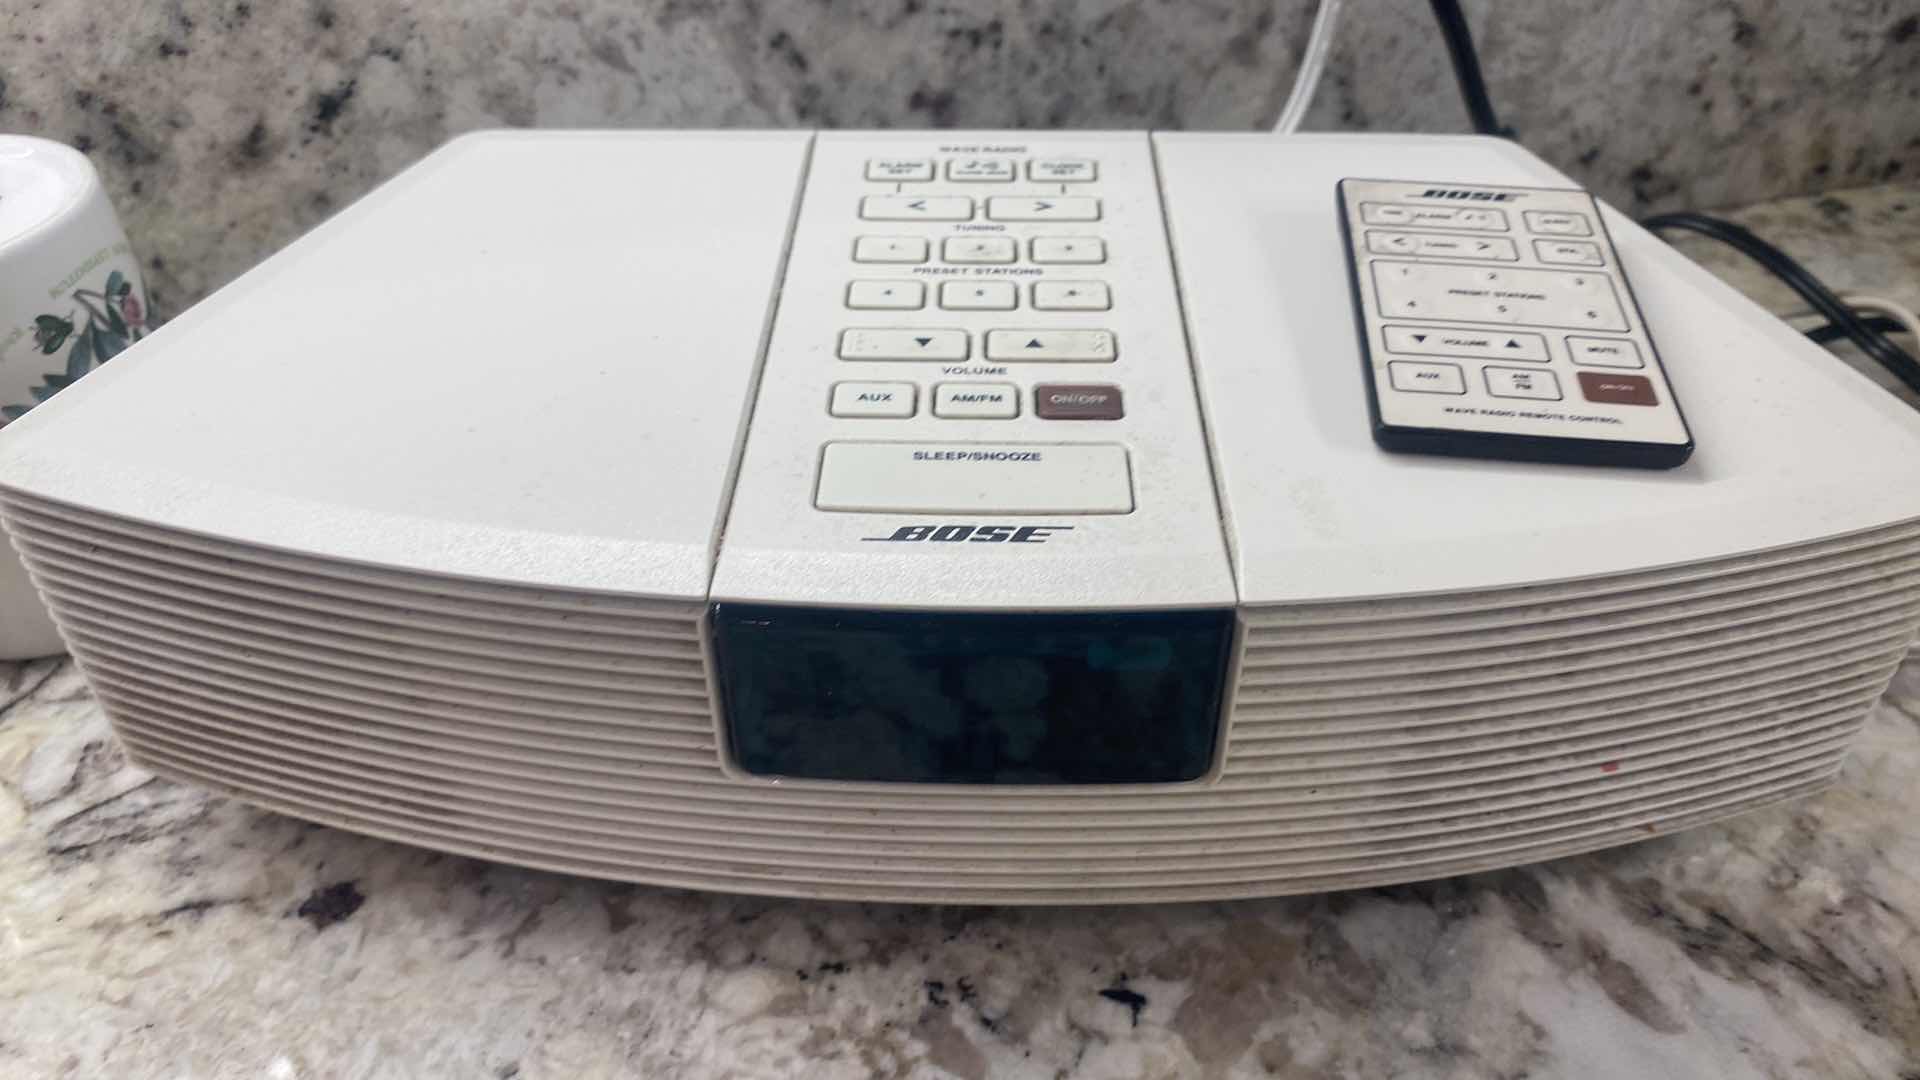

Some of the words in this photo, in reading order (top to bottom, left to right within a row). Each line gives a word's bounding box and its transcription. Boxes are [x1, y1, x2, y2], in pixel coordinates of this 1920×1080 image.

[953, 224, 1006, 232] TUNING
[912, 267, 968, 275] PRESET
[974, 267, 1044, 276] STATIONS
[941, 366, 1008, 376] VOLUME
[857, 392, 893, 402] AUX
[951, 394, 1003, 403] AM/FM
[1050, 394, 1109, 404] ON/OFF
[912, 451, 1043, 462] SLEEP/SNOOZE
[861, 525, 1074, 543] BOSE
